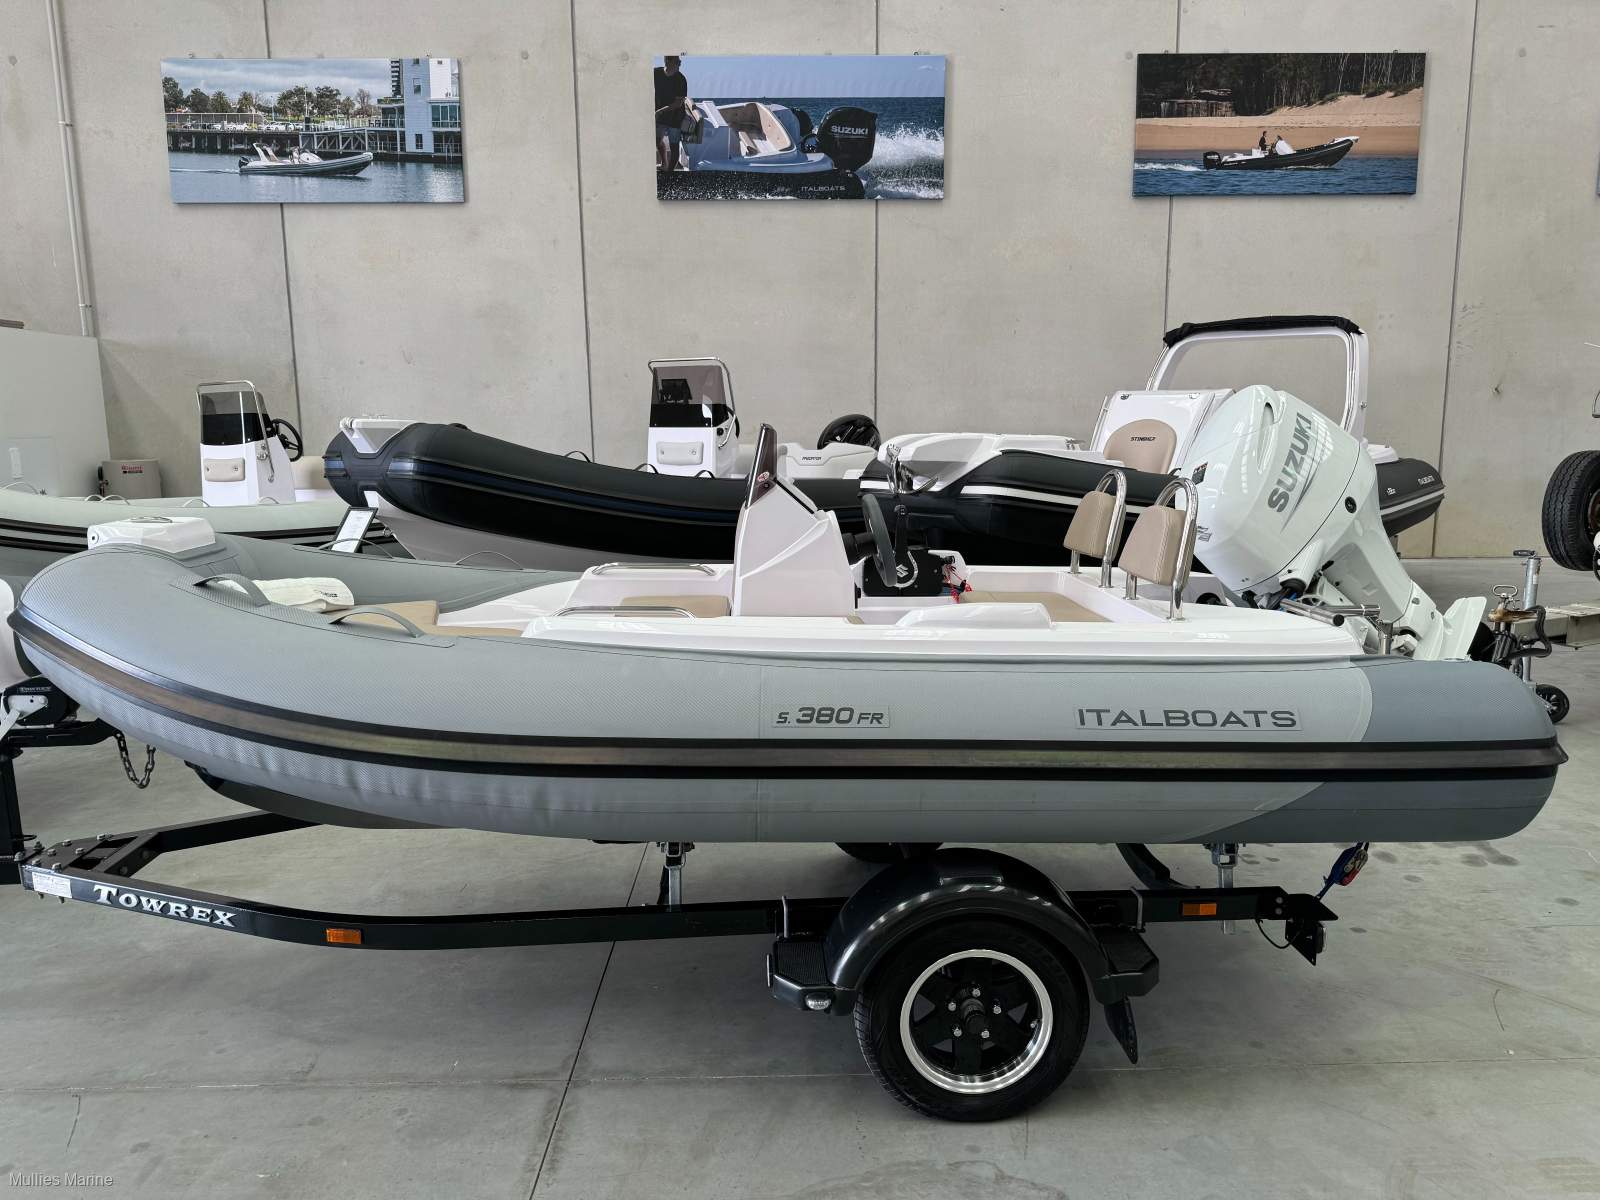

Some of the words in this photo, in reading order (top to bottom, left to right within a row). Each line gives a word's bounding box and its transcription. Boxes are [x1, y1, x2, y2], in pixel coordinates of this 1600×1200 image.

[831, 125, 869, 135] SUZUKI
[1267, 411, 1312, 513] SUZUKI
[776, 711, 791, 724] S.
[796, 706, 855, 724] 380
[857, 712, 884, 725] FR
[1078, 708, 1297, 728] ITALBOATS
[93, 884, 237, 928] TOWREX
